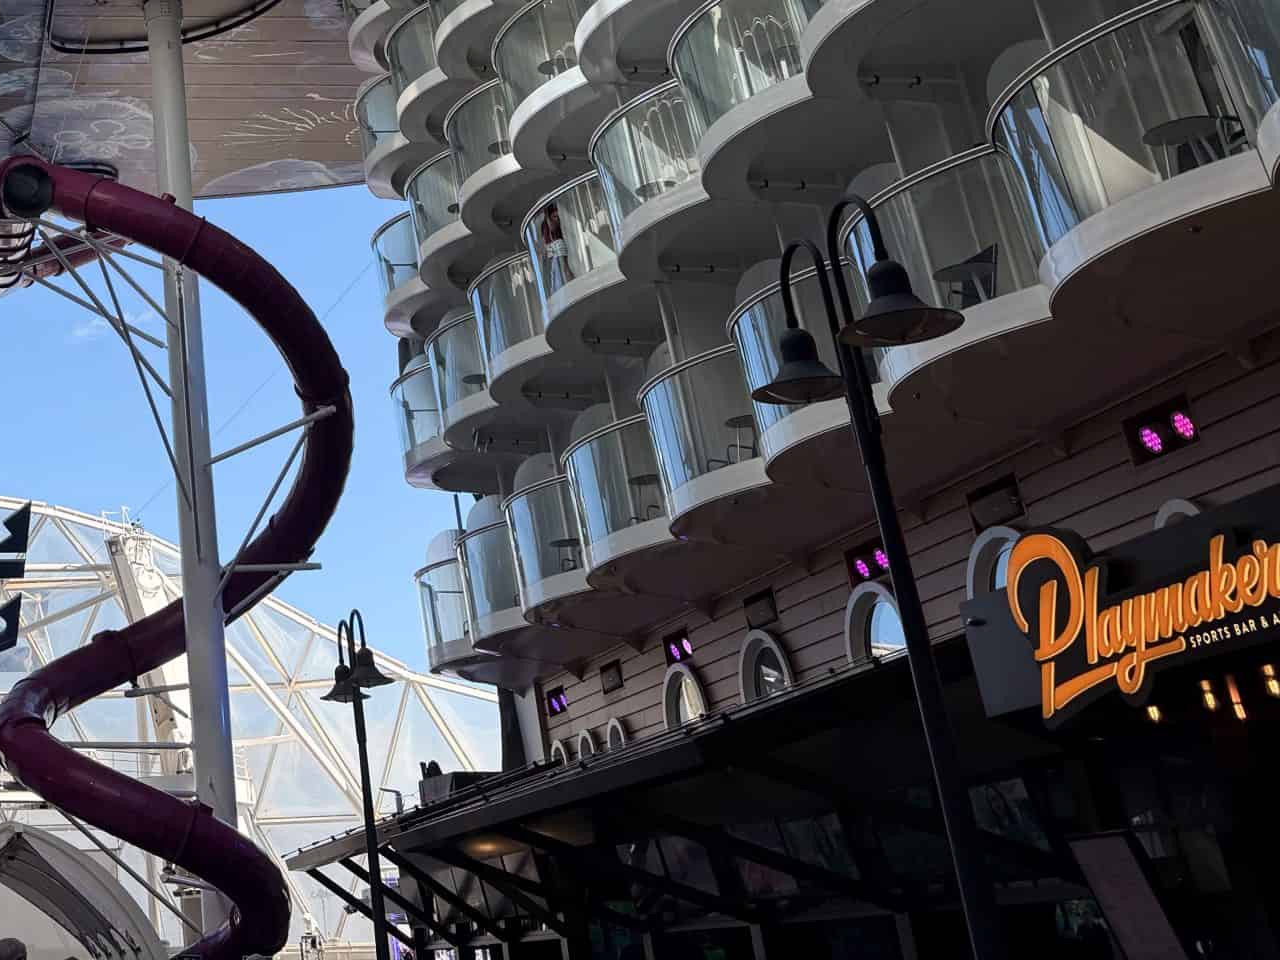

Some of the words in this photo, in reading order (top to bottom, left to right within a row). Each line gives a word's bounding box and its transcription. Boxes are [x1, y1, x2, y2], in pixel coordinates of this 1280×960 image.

[1189, 626, 1232, 648] SPORTS
[1233, 618, 1258, 637] BAR
[1260, 615, 1270, 629] &
